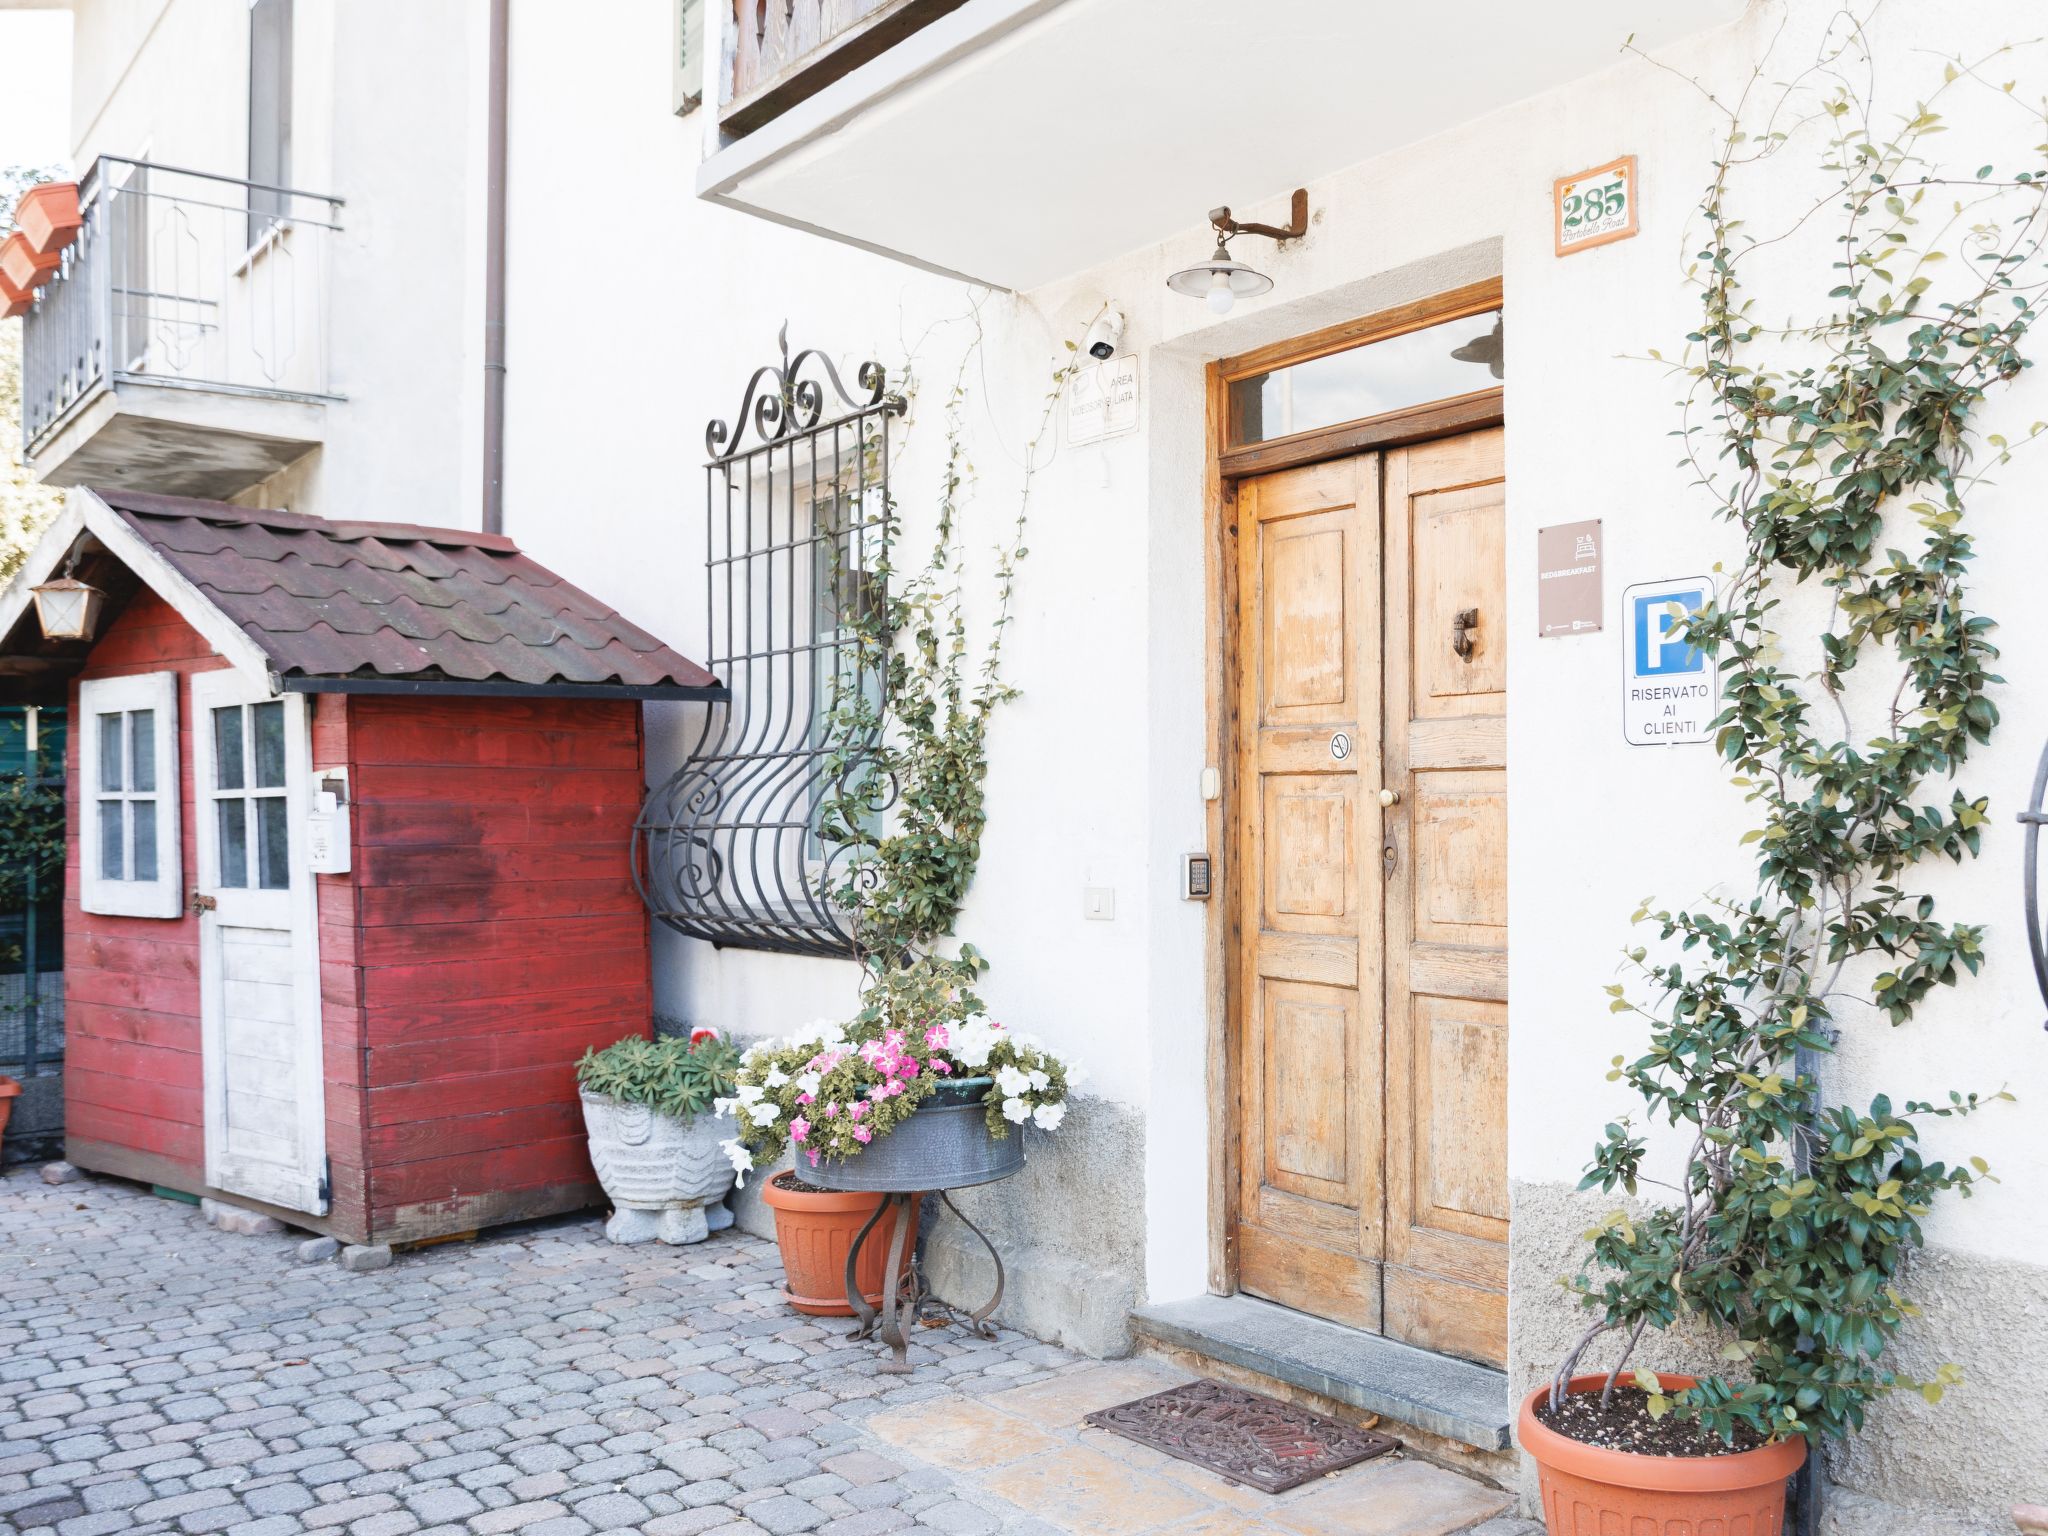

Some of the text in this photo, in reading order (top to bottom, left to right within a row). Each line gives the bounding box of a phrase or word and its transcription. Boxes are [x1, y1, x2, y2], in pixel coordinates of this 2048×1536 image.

[1562, 179, 1626, 229] 285
[1562, 212, 1627, 242] Portobello Road
[1110, 374, 1133, 388] AREA
[1647, 600, 1690, 669] P
[1631, 684, 1709, 701] RISERVATO
[1663, 704, 1676, 717] AI
[1643, 721, 1697, 735] CLIENTI
